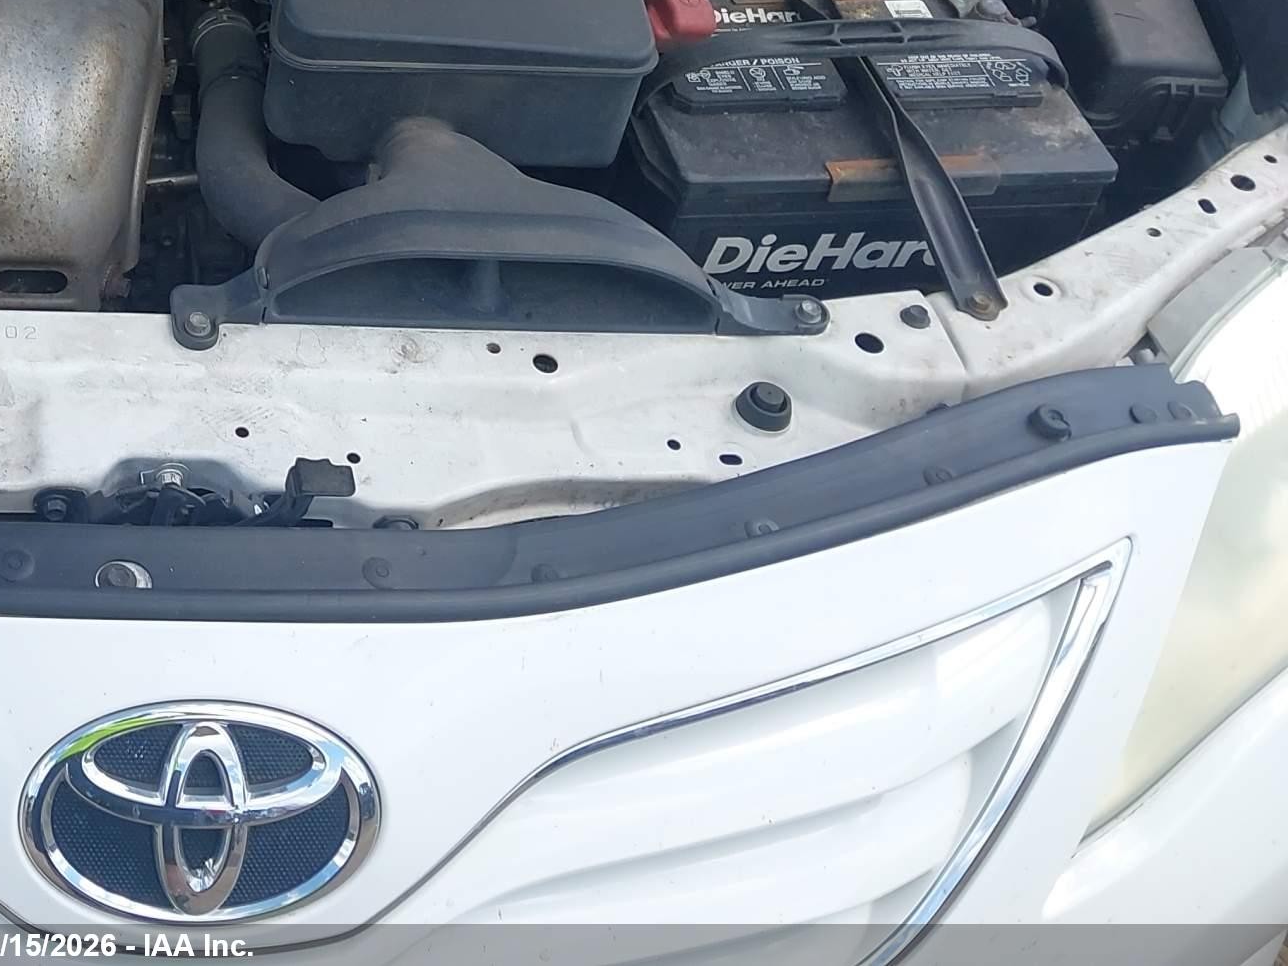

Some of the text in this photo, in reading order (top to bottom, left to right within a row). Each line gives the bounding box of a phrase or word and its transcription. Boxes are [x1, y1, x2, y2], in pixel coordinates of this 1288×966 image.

[713, 8, 801, 23] DieHar
[759, 57, 801, 65] POISON
[703, 231, 936, 274] DieHar
[761, 278, 825, 289] AHEAD
